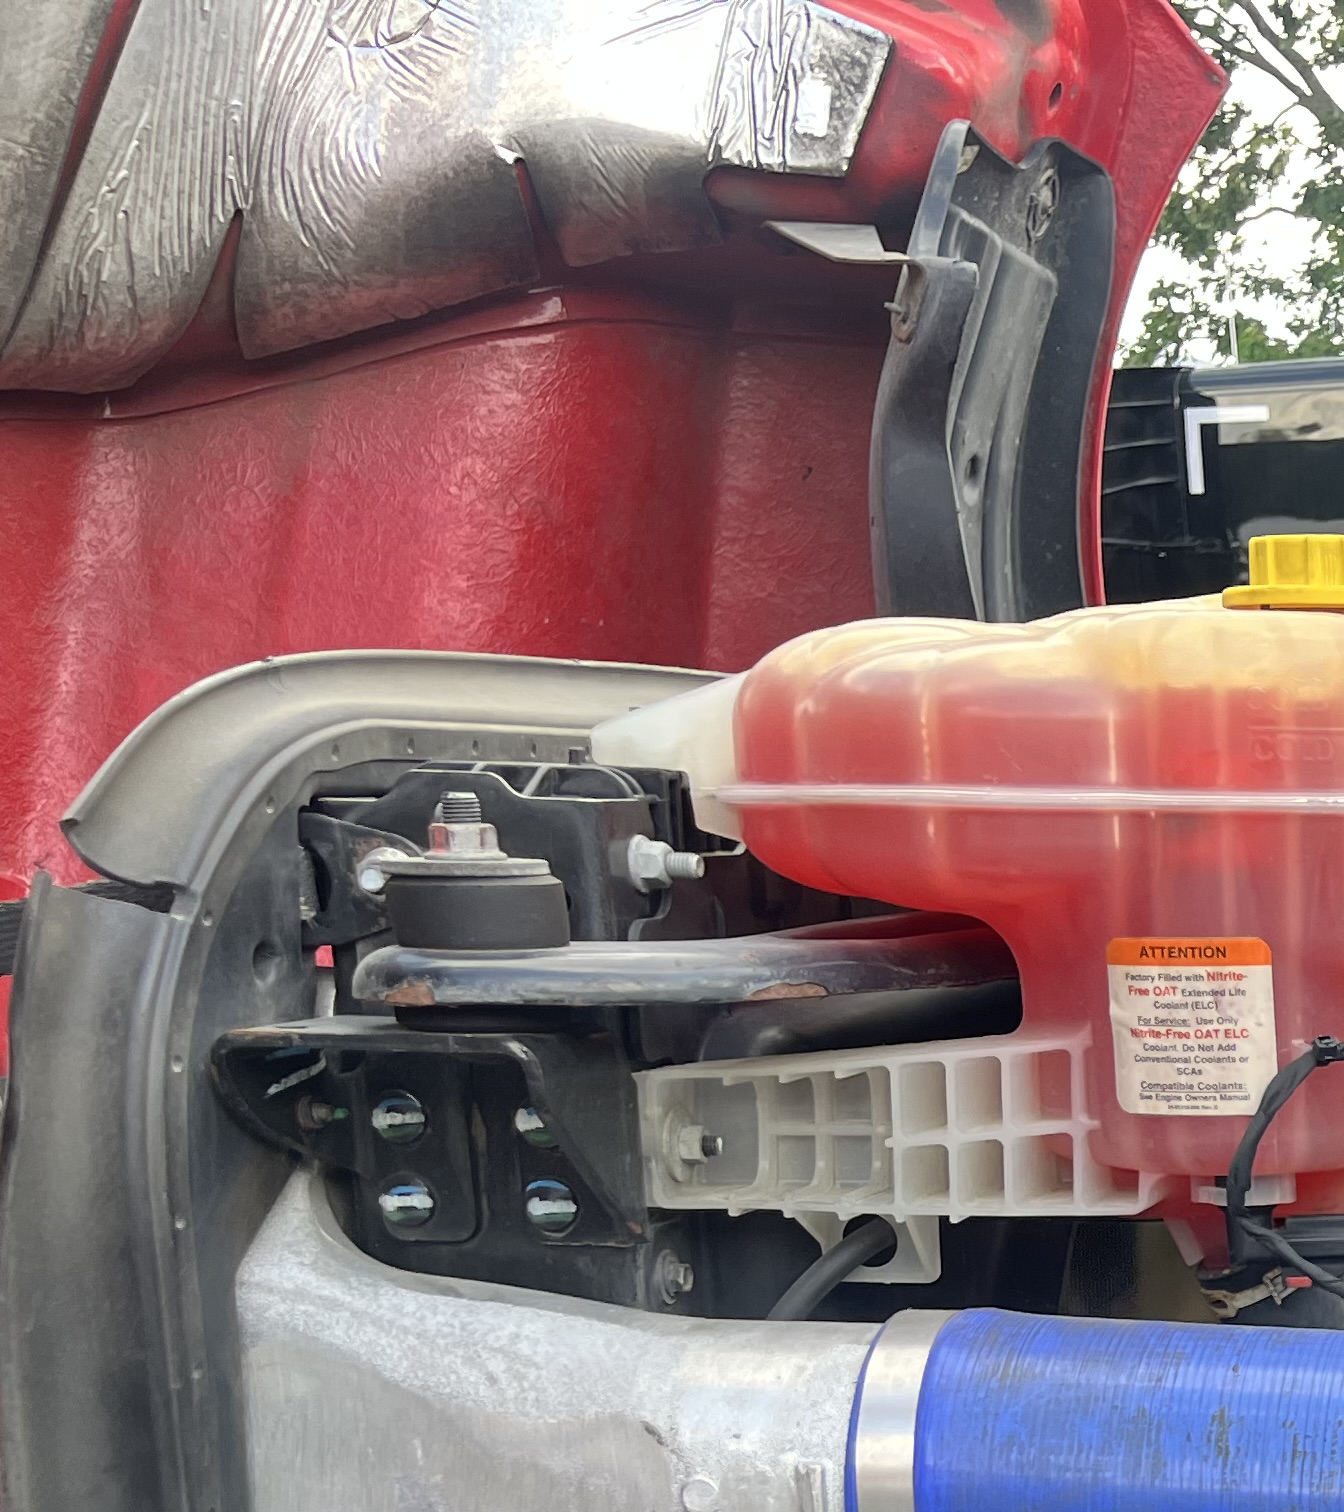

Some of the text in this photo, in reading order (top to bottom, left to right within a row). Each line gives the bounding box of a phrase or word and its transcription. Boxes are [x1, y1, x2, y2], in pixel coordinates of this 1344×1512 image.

[1139, 946, 1227, 959] ATTENTION
[1125, 971, 1249, 983] Factory Filled with Nitrite-
[1128, 985, 1247, 997] Free OAT Extended Life
[1153, 1000, 1219, 1011] Coolant (ELC)
[1137, 1016, 1240, 1027] For Service: Use Only
[1130, 1028, 1250, 1039] Nitrite-Free OAT ELC
[1182, 1043, 1195, 1052] Do
[1198, 1043, 1215, 1052] Not
[1217, 1043, 1237, 1052] Add
[1134, 1054, 1249, 1064] Conventional Coolants or
[1176, 1067, 1203, 1076] SCAs
[1140, 1081, 1248, 1092] Compatible Coolants:
[1139, 1093, 1251, 1102] See Engine Owners Manual
